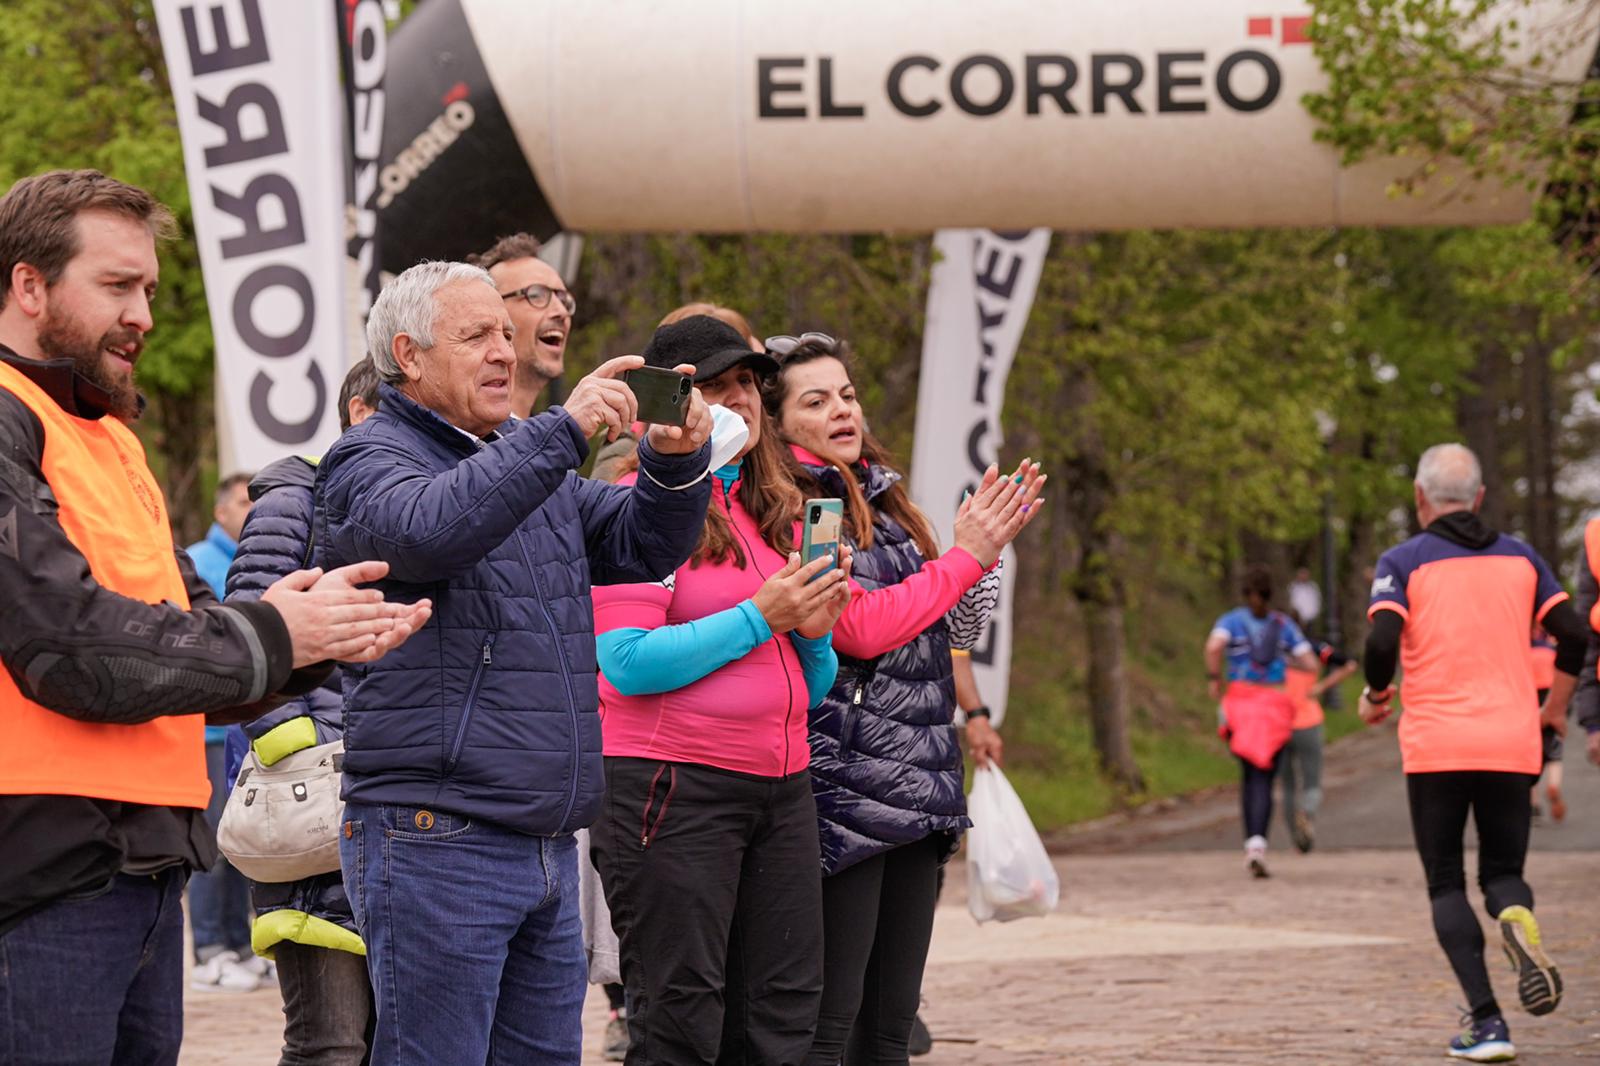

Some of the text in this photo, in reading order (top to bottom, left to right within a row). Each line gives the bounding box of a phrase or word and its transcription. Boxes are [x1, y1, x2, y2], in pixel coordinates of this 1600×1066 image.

[757, 49, 1282, 118] EL CORREO
[377, 100, 476, 208] ORREO
